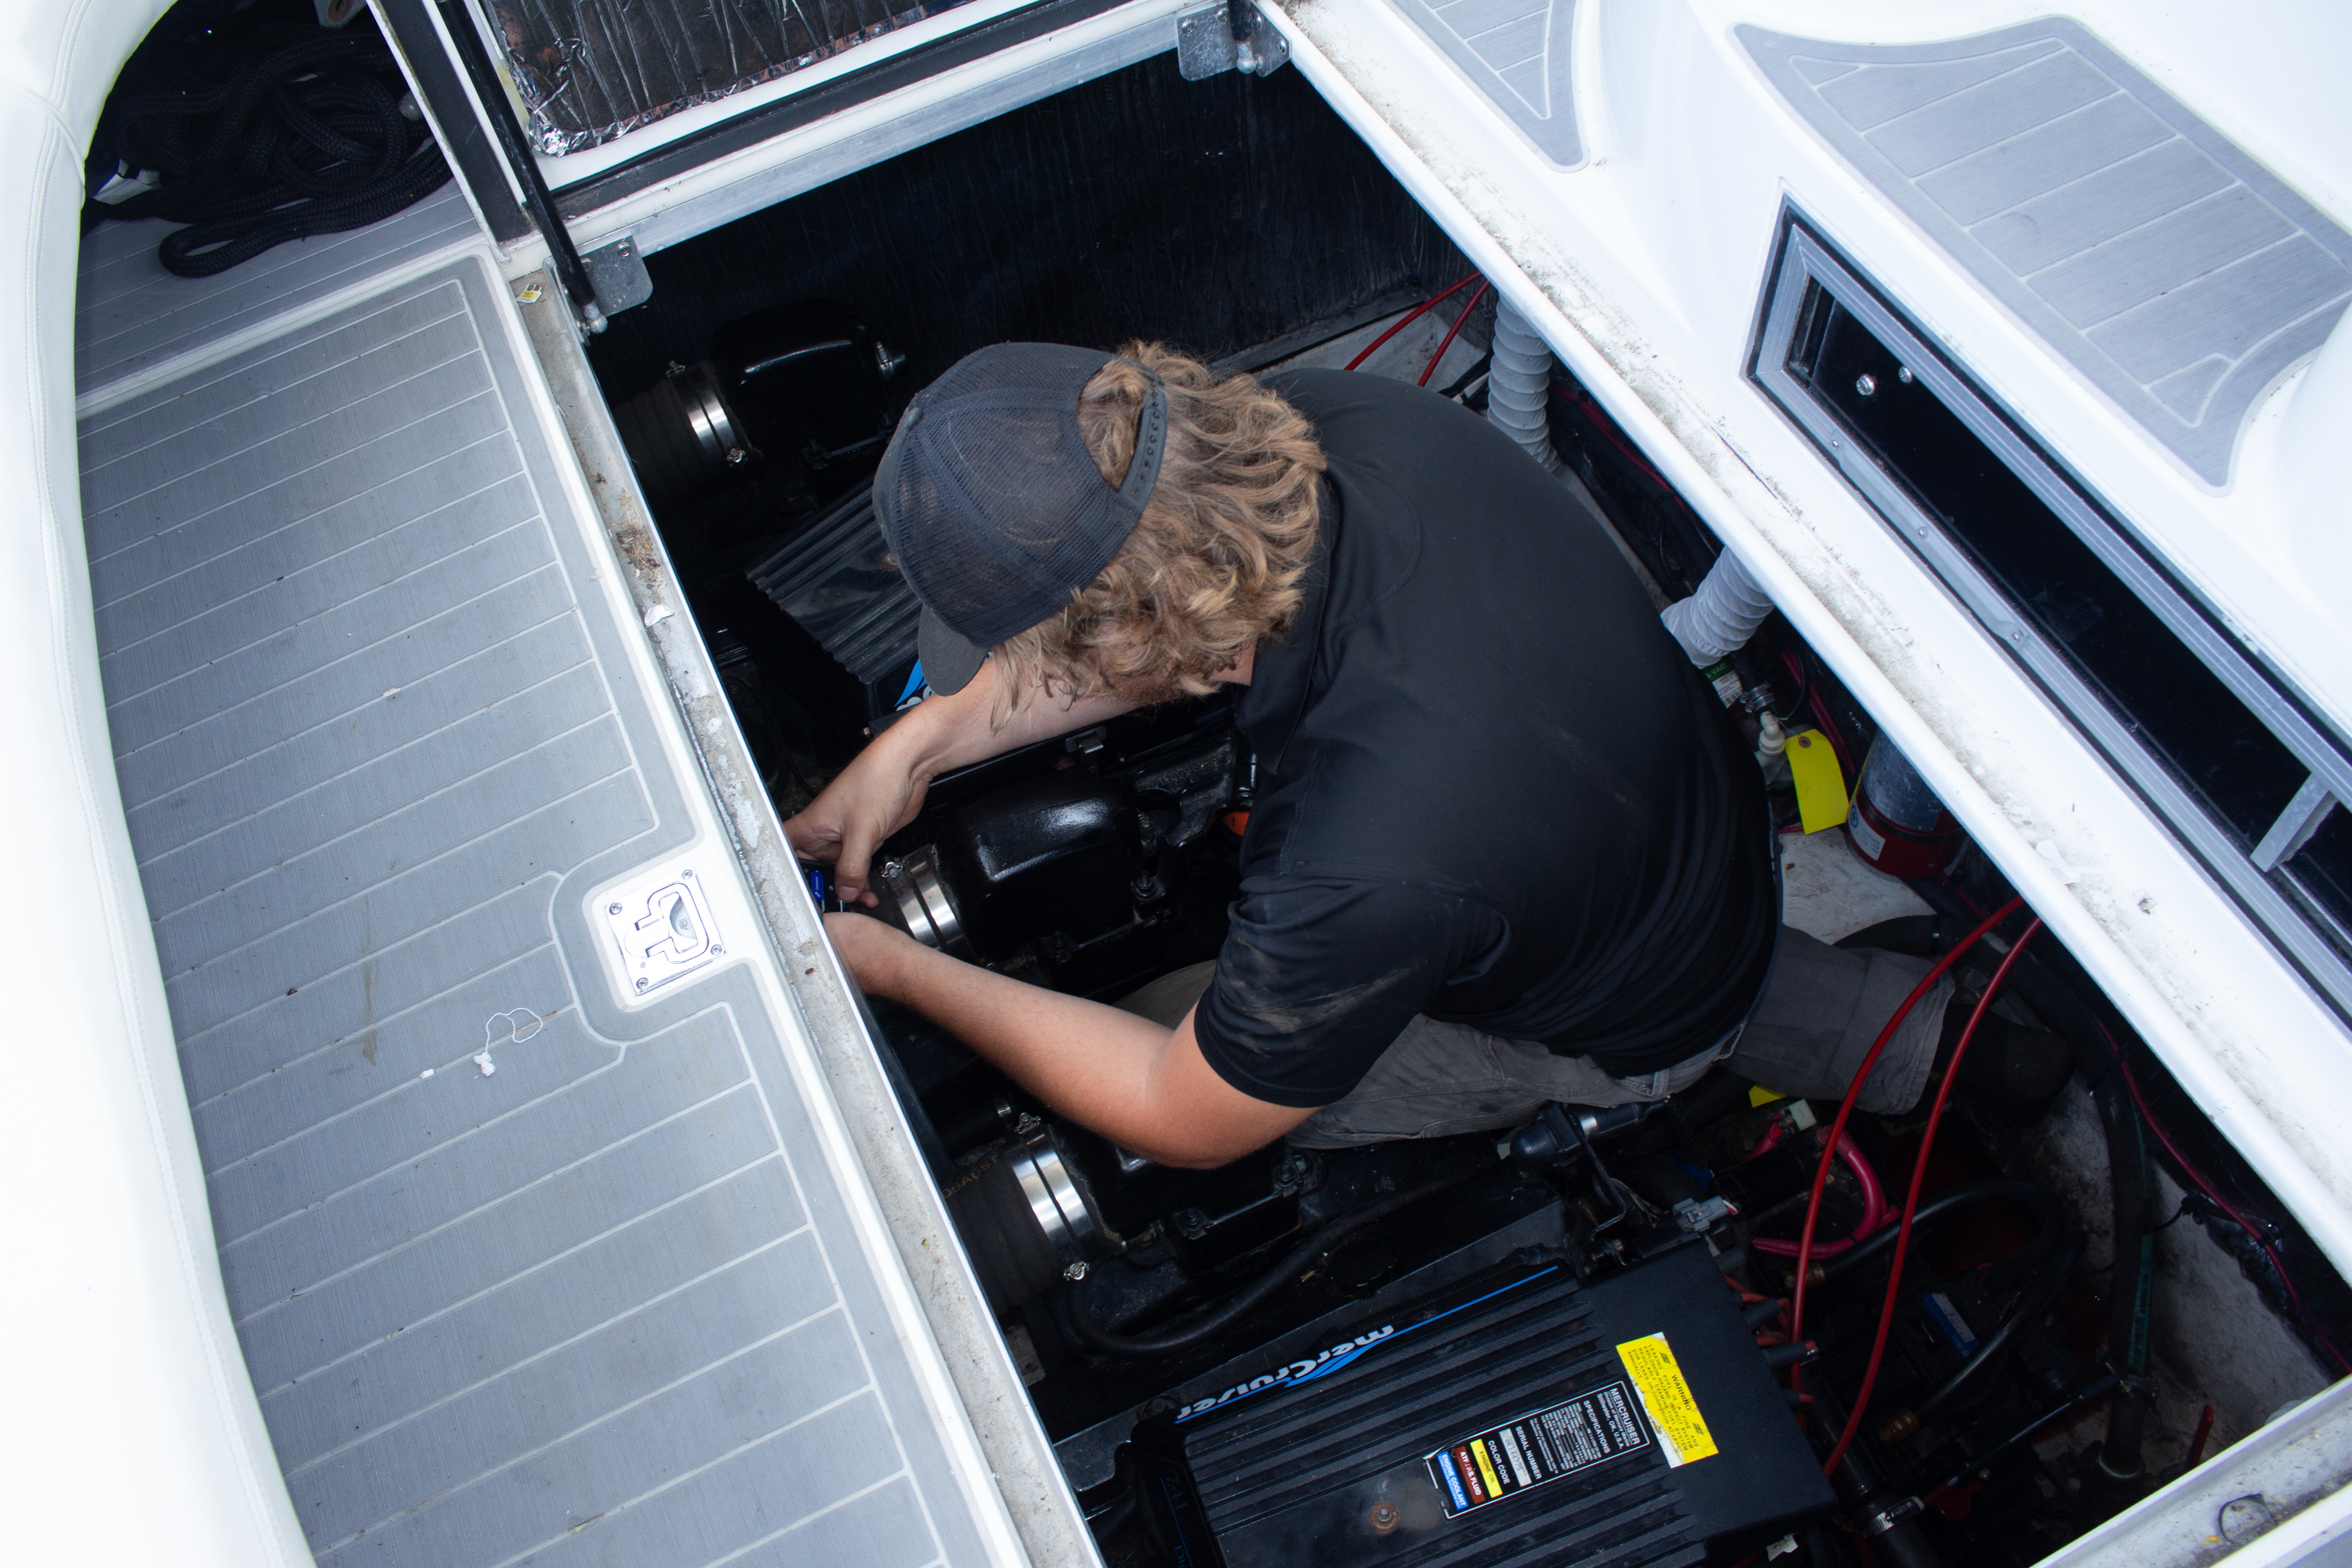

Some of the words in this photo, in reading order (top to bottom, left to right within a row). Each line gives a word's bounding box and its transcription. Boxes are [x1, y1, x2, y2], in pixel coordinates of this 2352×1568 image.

[1710, 663, 1727, 675] VAC
[678, 918, 689, 930] ABI
[1595, 1392, 1613, 1421] Stillwater,
[1632, 1349, 1641, 1361] FOR
[1637, 1362, 1650, 1380] LEAKS
[1646, 1382, 1654, 1390] OR
[1651, 1391, 1670, 1424] CORROSION
[1643, 1346, 1660, 1376] EXPLOSION
[1668, 1402, 1682, 1425] INSPECT
[1680, 1427, 1693, 1449] SYSTEM
[1648, 1344, 1663, 1370] LEAKING
[1662, 1374, 1672, 1389] FUEL
[1681, 1415, 1690, 1429] FIRE
[1690, 1435, 1699, 1447] AND
[1671, 1374, 1692, 1411] WARNING
[1582, 1399, 1612, 1454] SPECIFICATIONS
[1602, 1391, 1614, 1409] Division
[1612, 1413, 1624, 1432] Mercury
[1620, 1431, 1631, 1447] Marine
[1607, 1419, 1618, 1432] OK,
[1609, 1387, 1641, 1445] MERCRUISER
[1612, 1431, 1626, 1450] U.S.A.
[1654, 1383, 1669, 1409] EXAMINE
[1666, 1411, 1676, 1425] FUEL
[1674, 1427, 1688, 1451] SYSTEM
[1459, 1450, 1470, 1464] ATF
[1469, 1476, 1482, 1496] FLUID
[1479, 1450, 1491, 1473] ENGINE
[1488, 1473, 1496, 1484] OIL
[1487, 1440, 1503, 1464] COLOR
[1497, 1463, 1511, 1485] CODE
[1514, 1425, 1530, 1450] SERIAL
[1524, 1449, 1543, 1480] NUMBER
[1441, 1453, 1455, 1477] ENGINE
[1450, 1476, 1467, 1507] COOLANT
